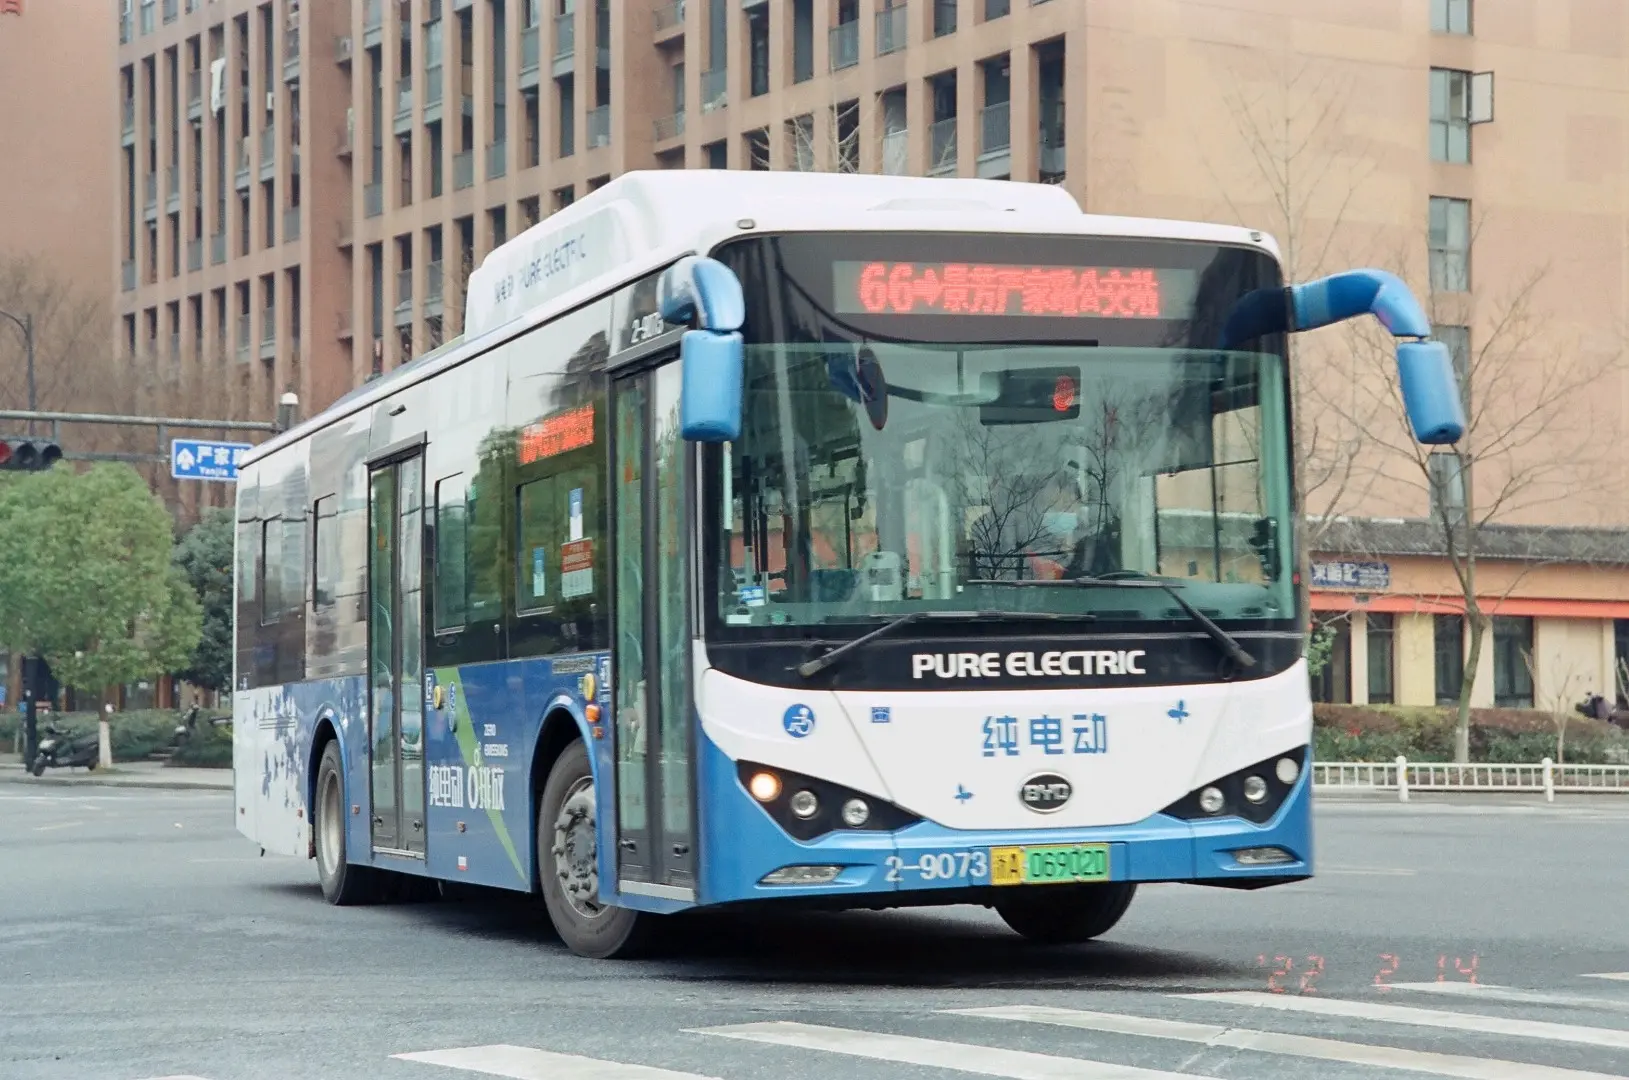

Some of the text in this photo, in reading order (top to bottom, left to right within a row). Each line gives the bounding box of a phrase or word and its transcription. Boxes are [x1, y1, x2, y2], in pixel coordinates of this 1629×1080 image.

[860, 262, 914, 313] 66
[911, 649, 1147, 680] PURE ELECTRIC
[981, 713, 1110, 757] 纯电动
[1023, 783, 1069, 801] BYD
[883, 851, 988, 883] 2-9073
